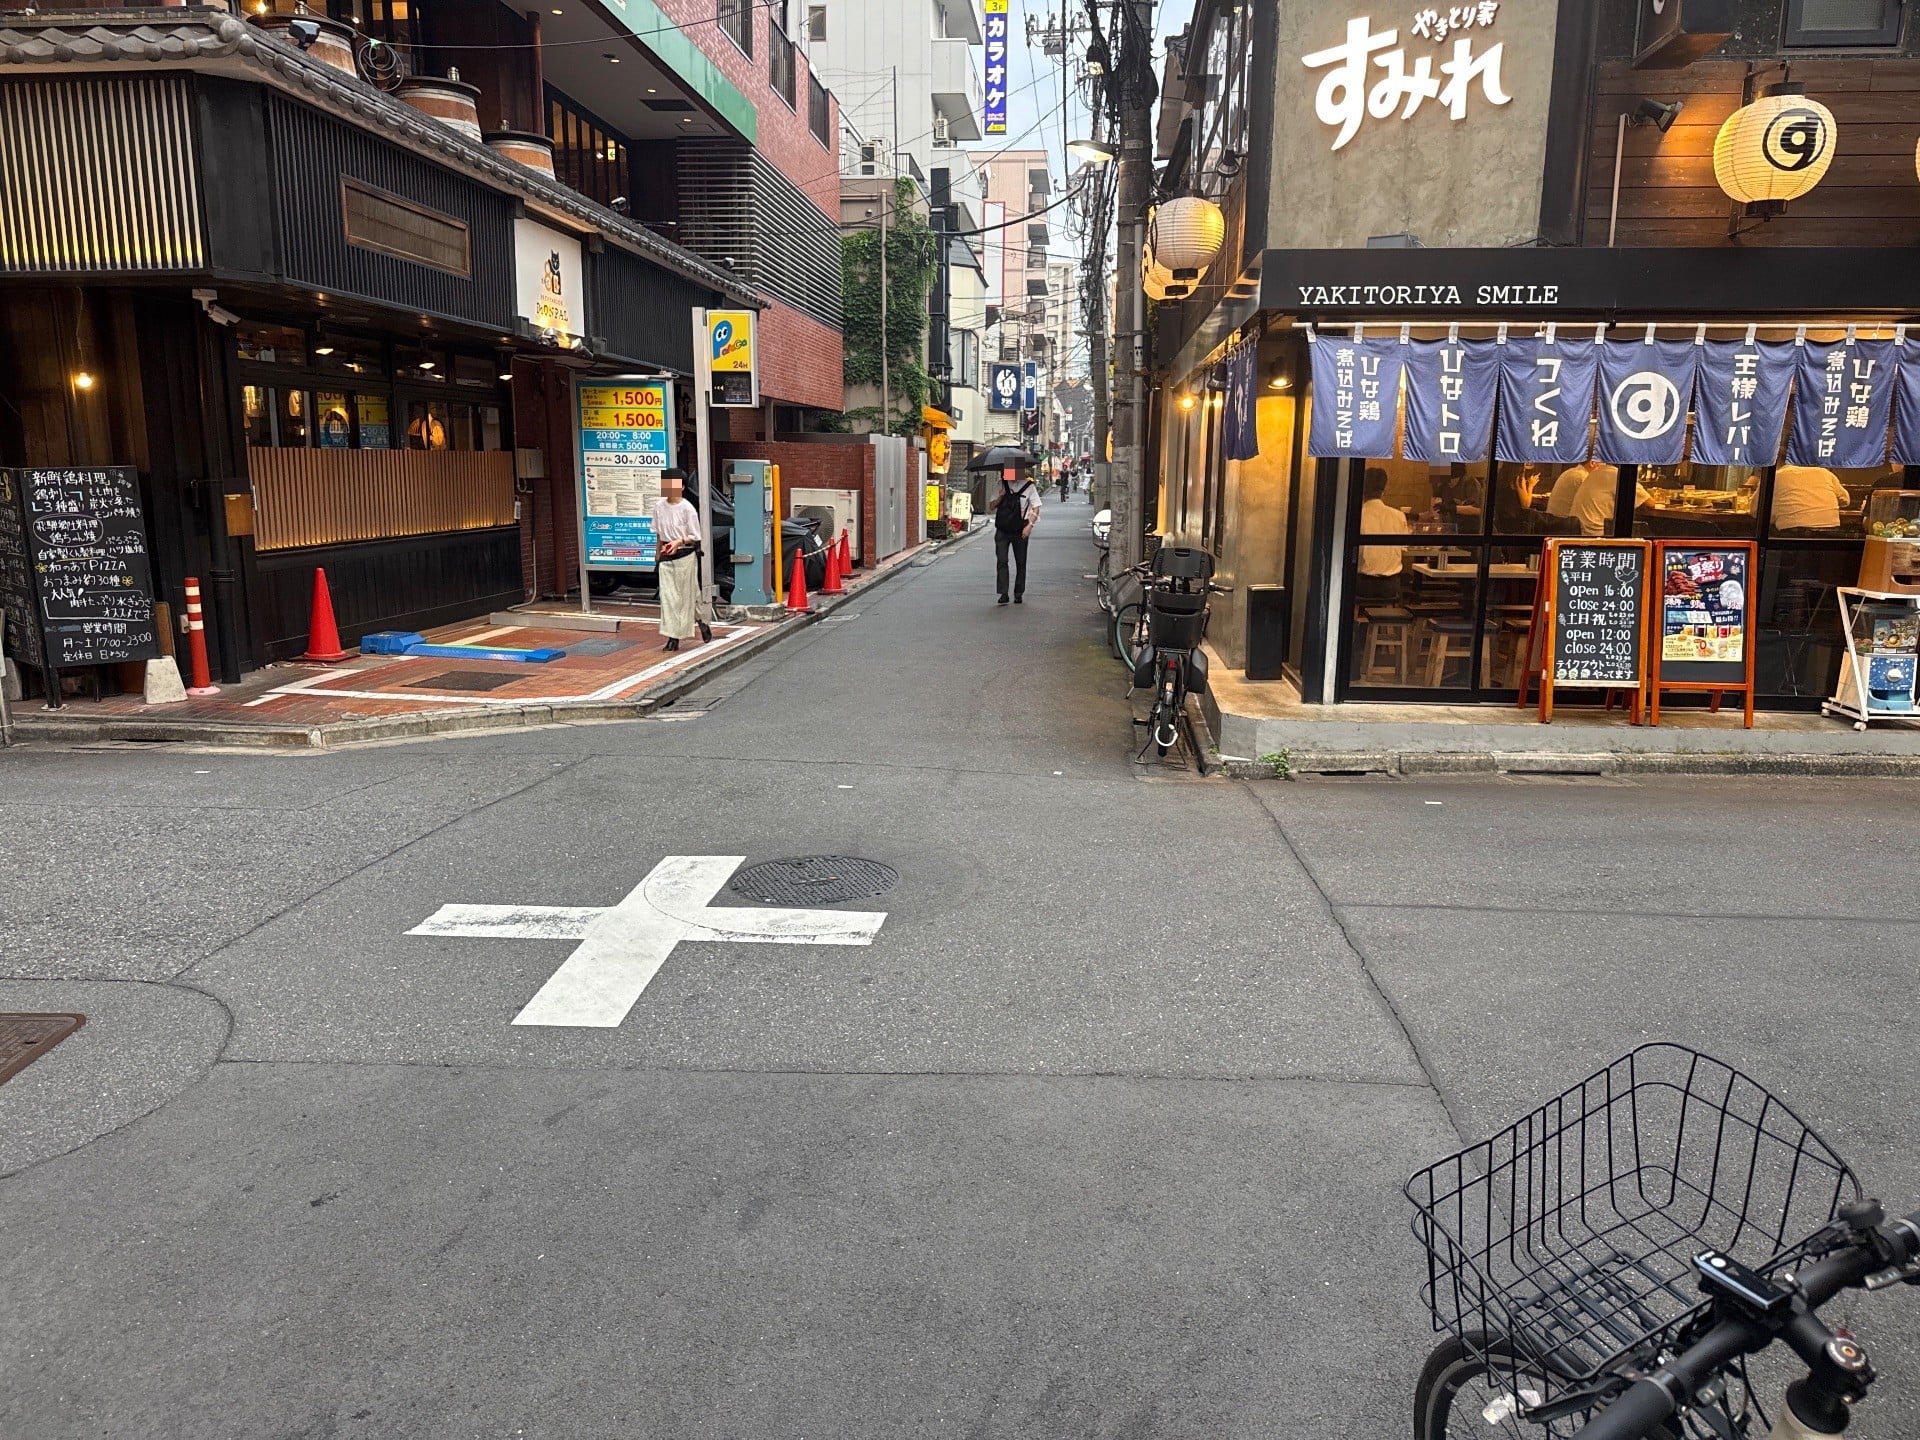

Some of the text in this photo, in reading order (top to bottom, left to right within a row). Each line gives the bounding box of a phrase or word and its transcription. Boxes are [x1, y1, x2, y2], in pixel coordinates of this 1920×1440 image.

[991, 2, 1003, 11] 3F
[1411, 0, 1499, 42] やきとり家
[986, 17, 1005, 108] カラオケ
[1301, 16, 1514, 152] すみれ
[1298, 285, 1558, 305] YAKITORIYA SMILE
[733, 361, 748, 369] 24H
[1358, 355, 1380, 421] ひな鶏
[1844, 358, 1876, 431] ひな鶏
[1335, 348, 1355, 448] 煮込みそば
[1438, 348, 1465, 454] ひなトロ
[1530, 357, 1563, 448] つくね
[1726, 353, 1761, 461] 王様レバー
[1817, 350, 1847, 459] 煮込みそば
[1559, 550, 1636, 569] 営業時間
[1569, 571, 1592, 582] 平日
[1688, 560, 1724, 580] 夏祭り
[1604, 584, 1634, 598] 16:00
[1602, 600, 1634, 612] 24:00
[83, 623, 127, 635] 営業時間
[1601, 628, 1631, 641] 12:00
[63, 651, 93, 662] 定休日
[1599, 642, 1632, 655] 24:00
[1556, 659, 1605, 670] テイクアウト
[1592, 669, 1634, 679] やってます
